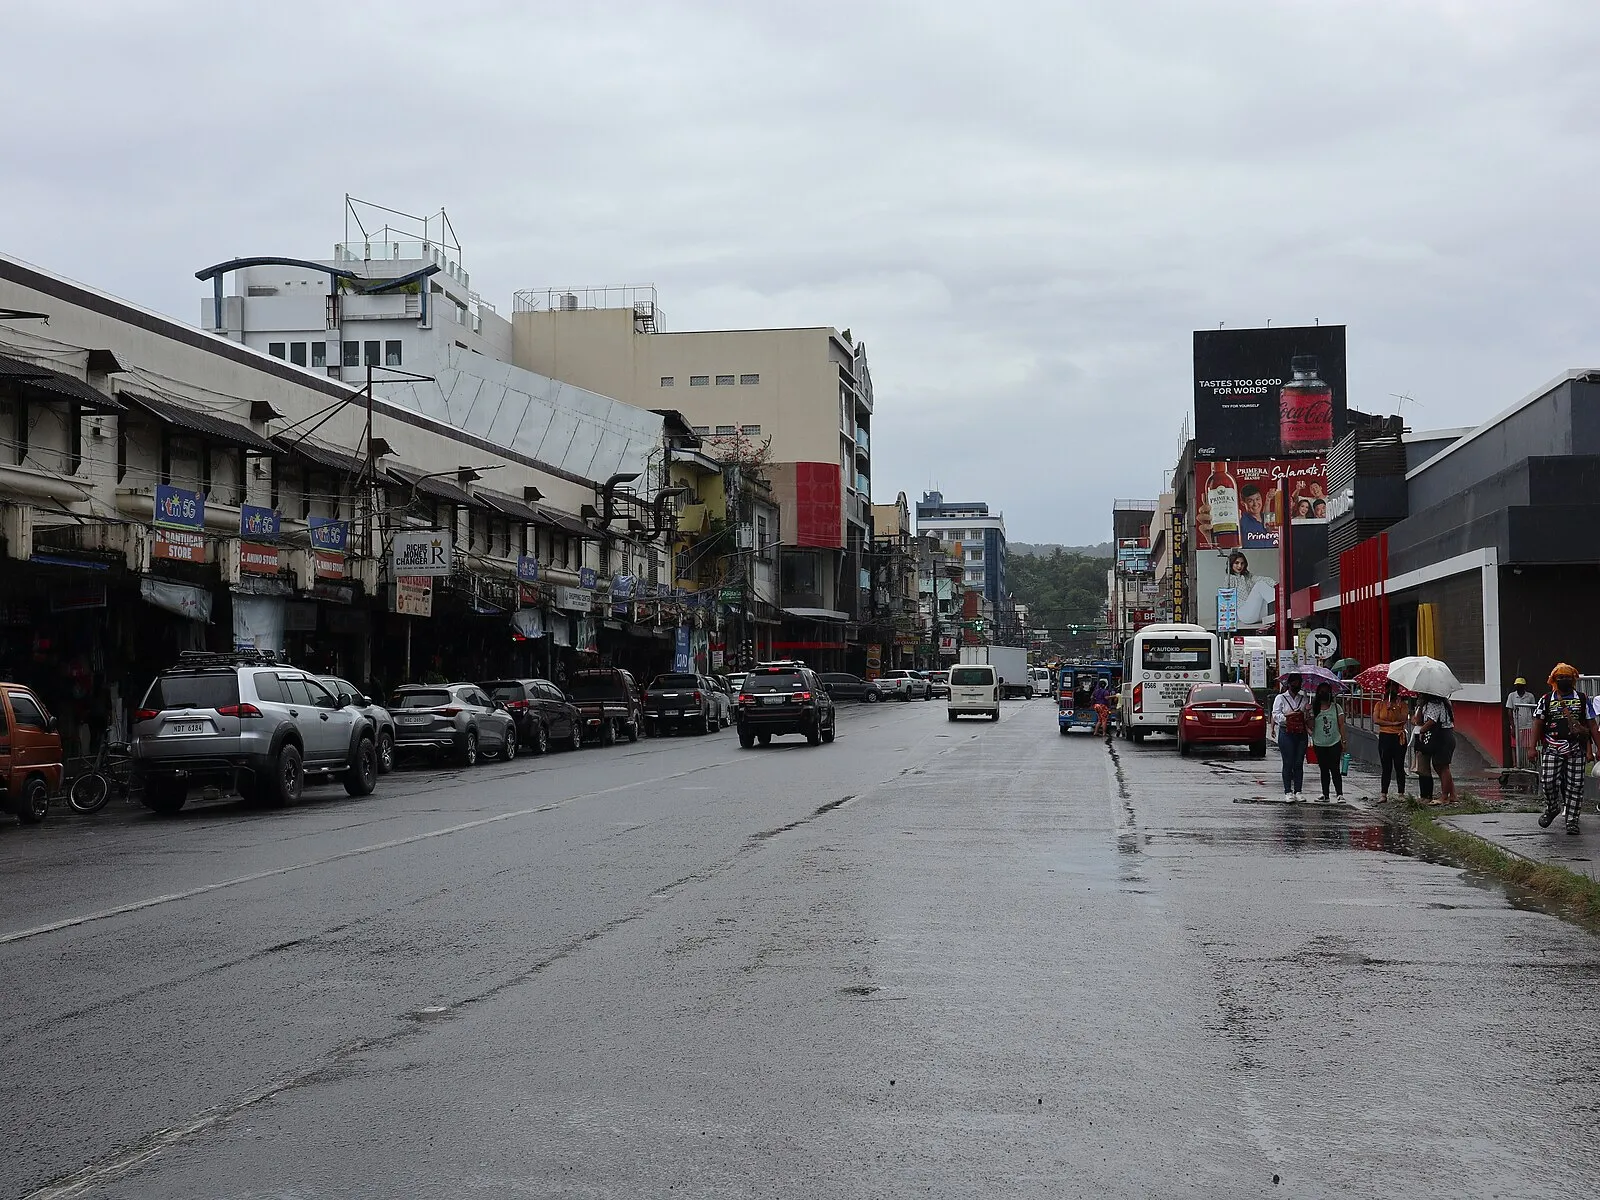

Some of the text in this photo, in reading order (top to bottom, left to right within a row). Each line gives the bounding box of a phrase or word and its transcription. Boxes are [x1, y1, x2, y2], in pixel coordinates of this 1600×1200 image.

[1255, 378, 1282, 386] GOOD
[1233, 386, 1268, 394] WORDS
[1236, 467, 1268, 475] PRIMERA
[182, 498, 196, 519] 5G
[262, 516, 273, 534] 5G
[331, 527, 341, 544] 5G
[1174, 517, 1182, 558] LUCKY
[1247, 532, 1279, 540] Primera
[168, 545, 192, 559] STORE
[406, 543, 428, 552] RICHIE
[404, 550, 428, 559] MONEY
[430, 546, 447, 565] R
[263, 555, 278, 566] STORE
[396, 557, 428, 566] CHANGER
